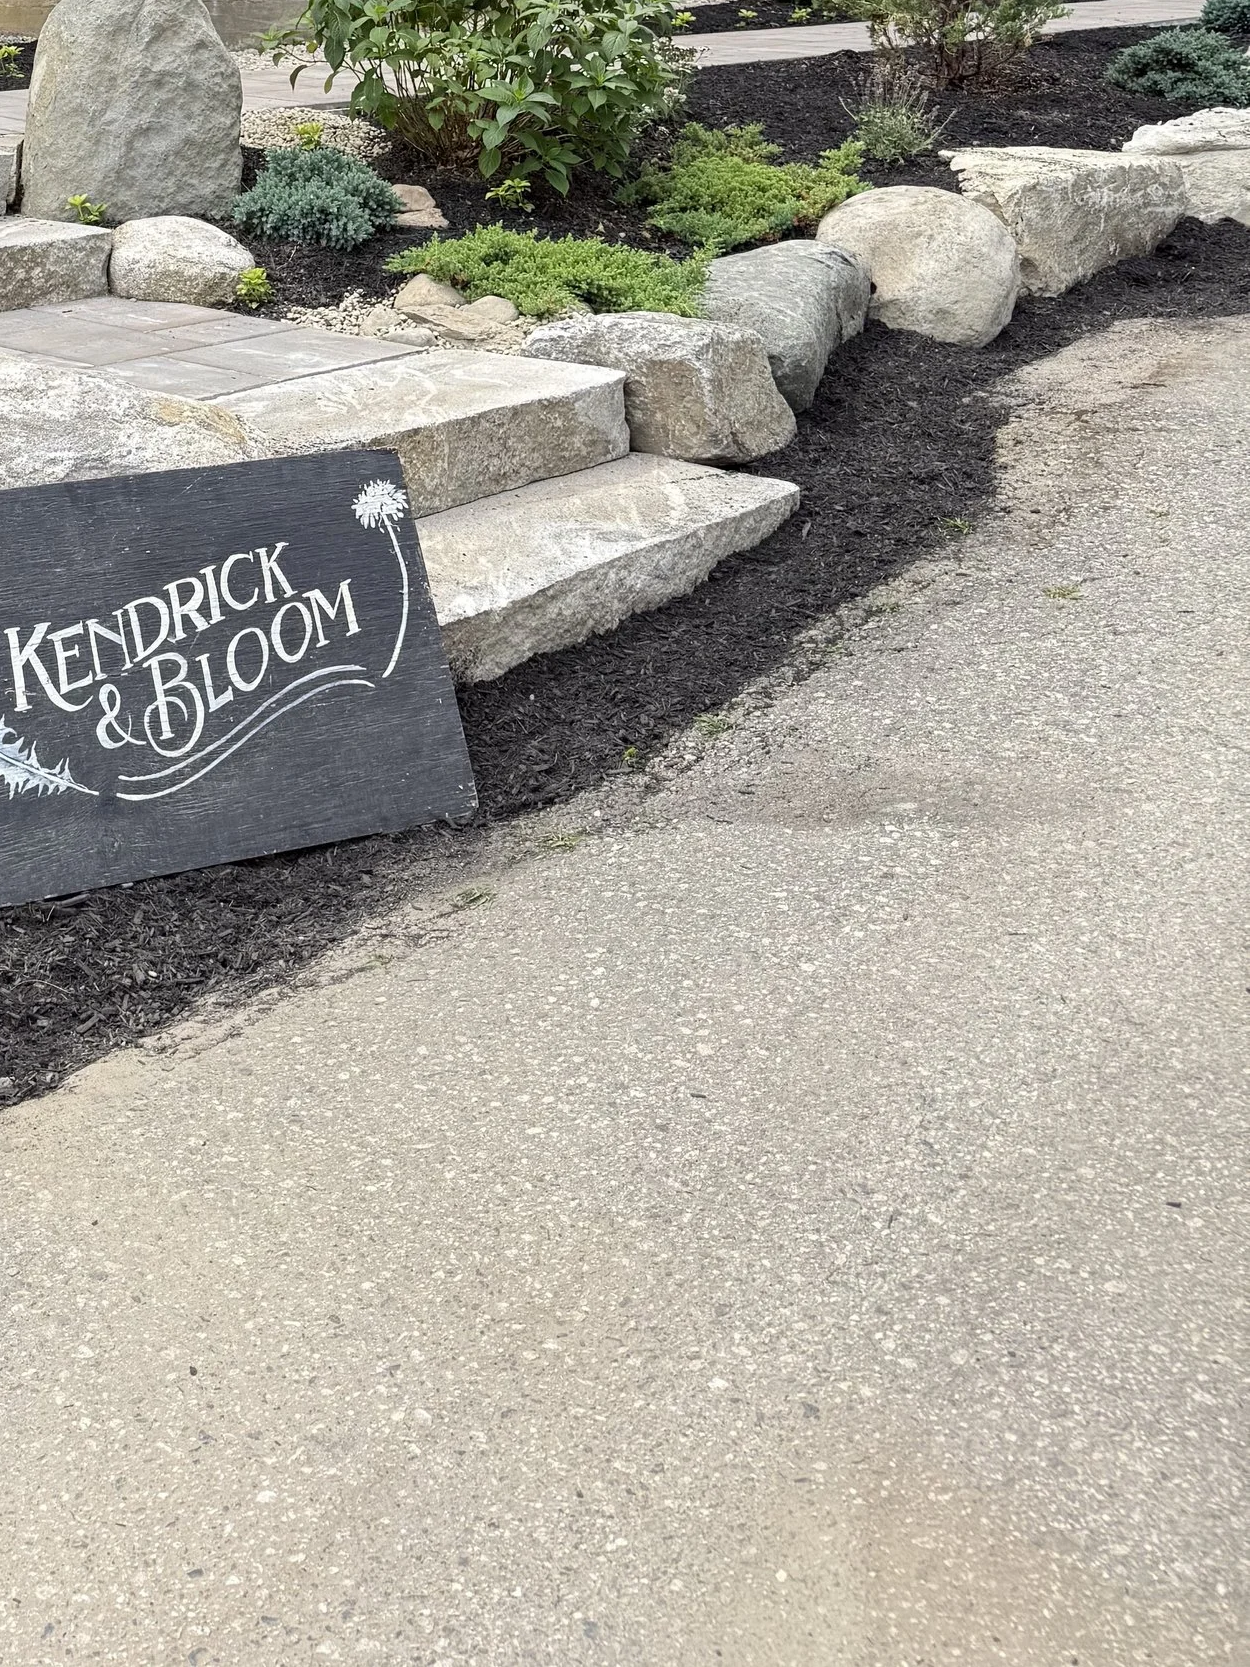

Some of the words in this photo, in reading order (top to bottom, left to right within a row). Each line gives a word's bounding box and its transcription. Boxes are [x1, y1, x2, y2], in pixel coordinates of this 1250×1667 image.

[3, 541, 299, 712] KENDRICK
[95, 683, 148, 749] &
[142, 578, 363, 758] BLOOM
